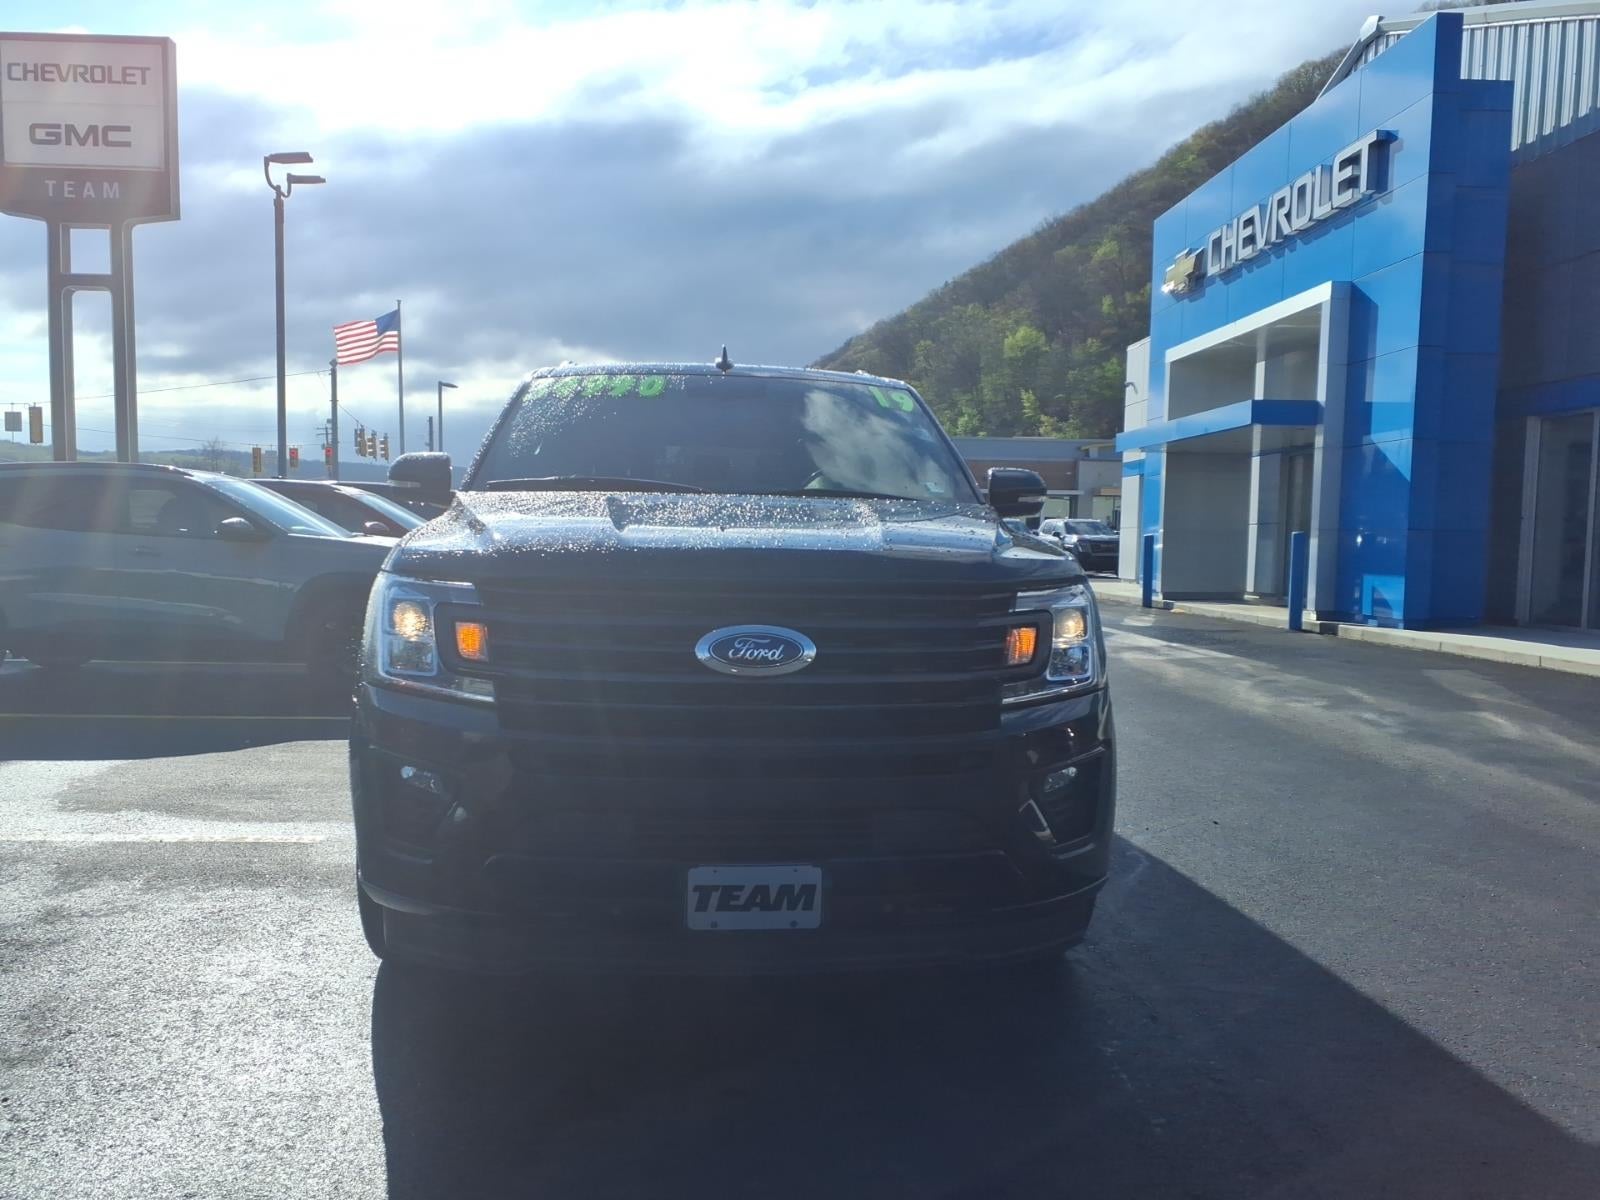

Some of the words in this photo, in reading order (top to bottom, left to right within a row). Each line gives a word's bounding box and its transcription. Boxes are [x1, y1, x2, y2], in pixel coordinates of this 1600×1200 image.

[7, 62, 152, 85] CHEVROLET
[29, 122, 132, 148] GMC
[45, 180, 120, 199] TEAM
[1206, 129, 1398, 277] CHEVROLET
[728, 637, 784, 660] Ford
[692, 883, 817, 912] TEAM
